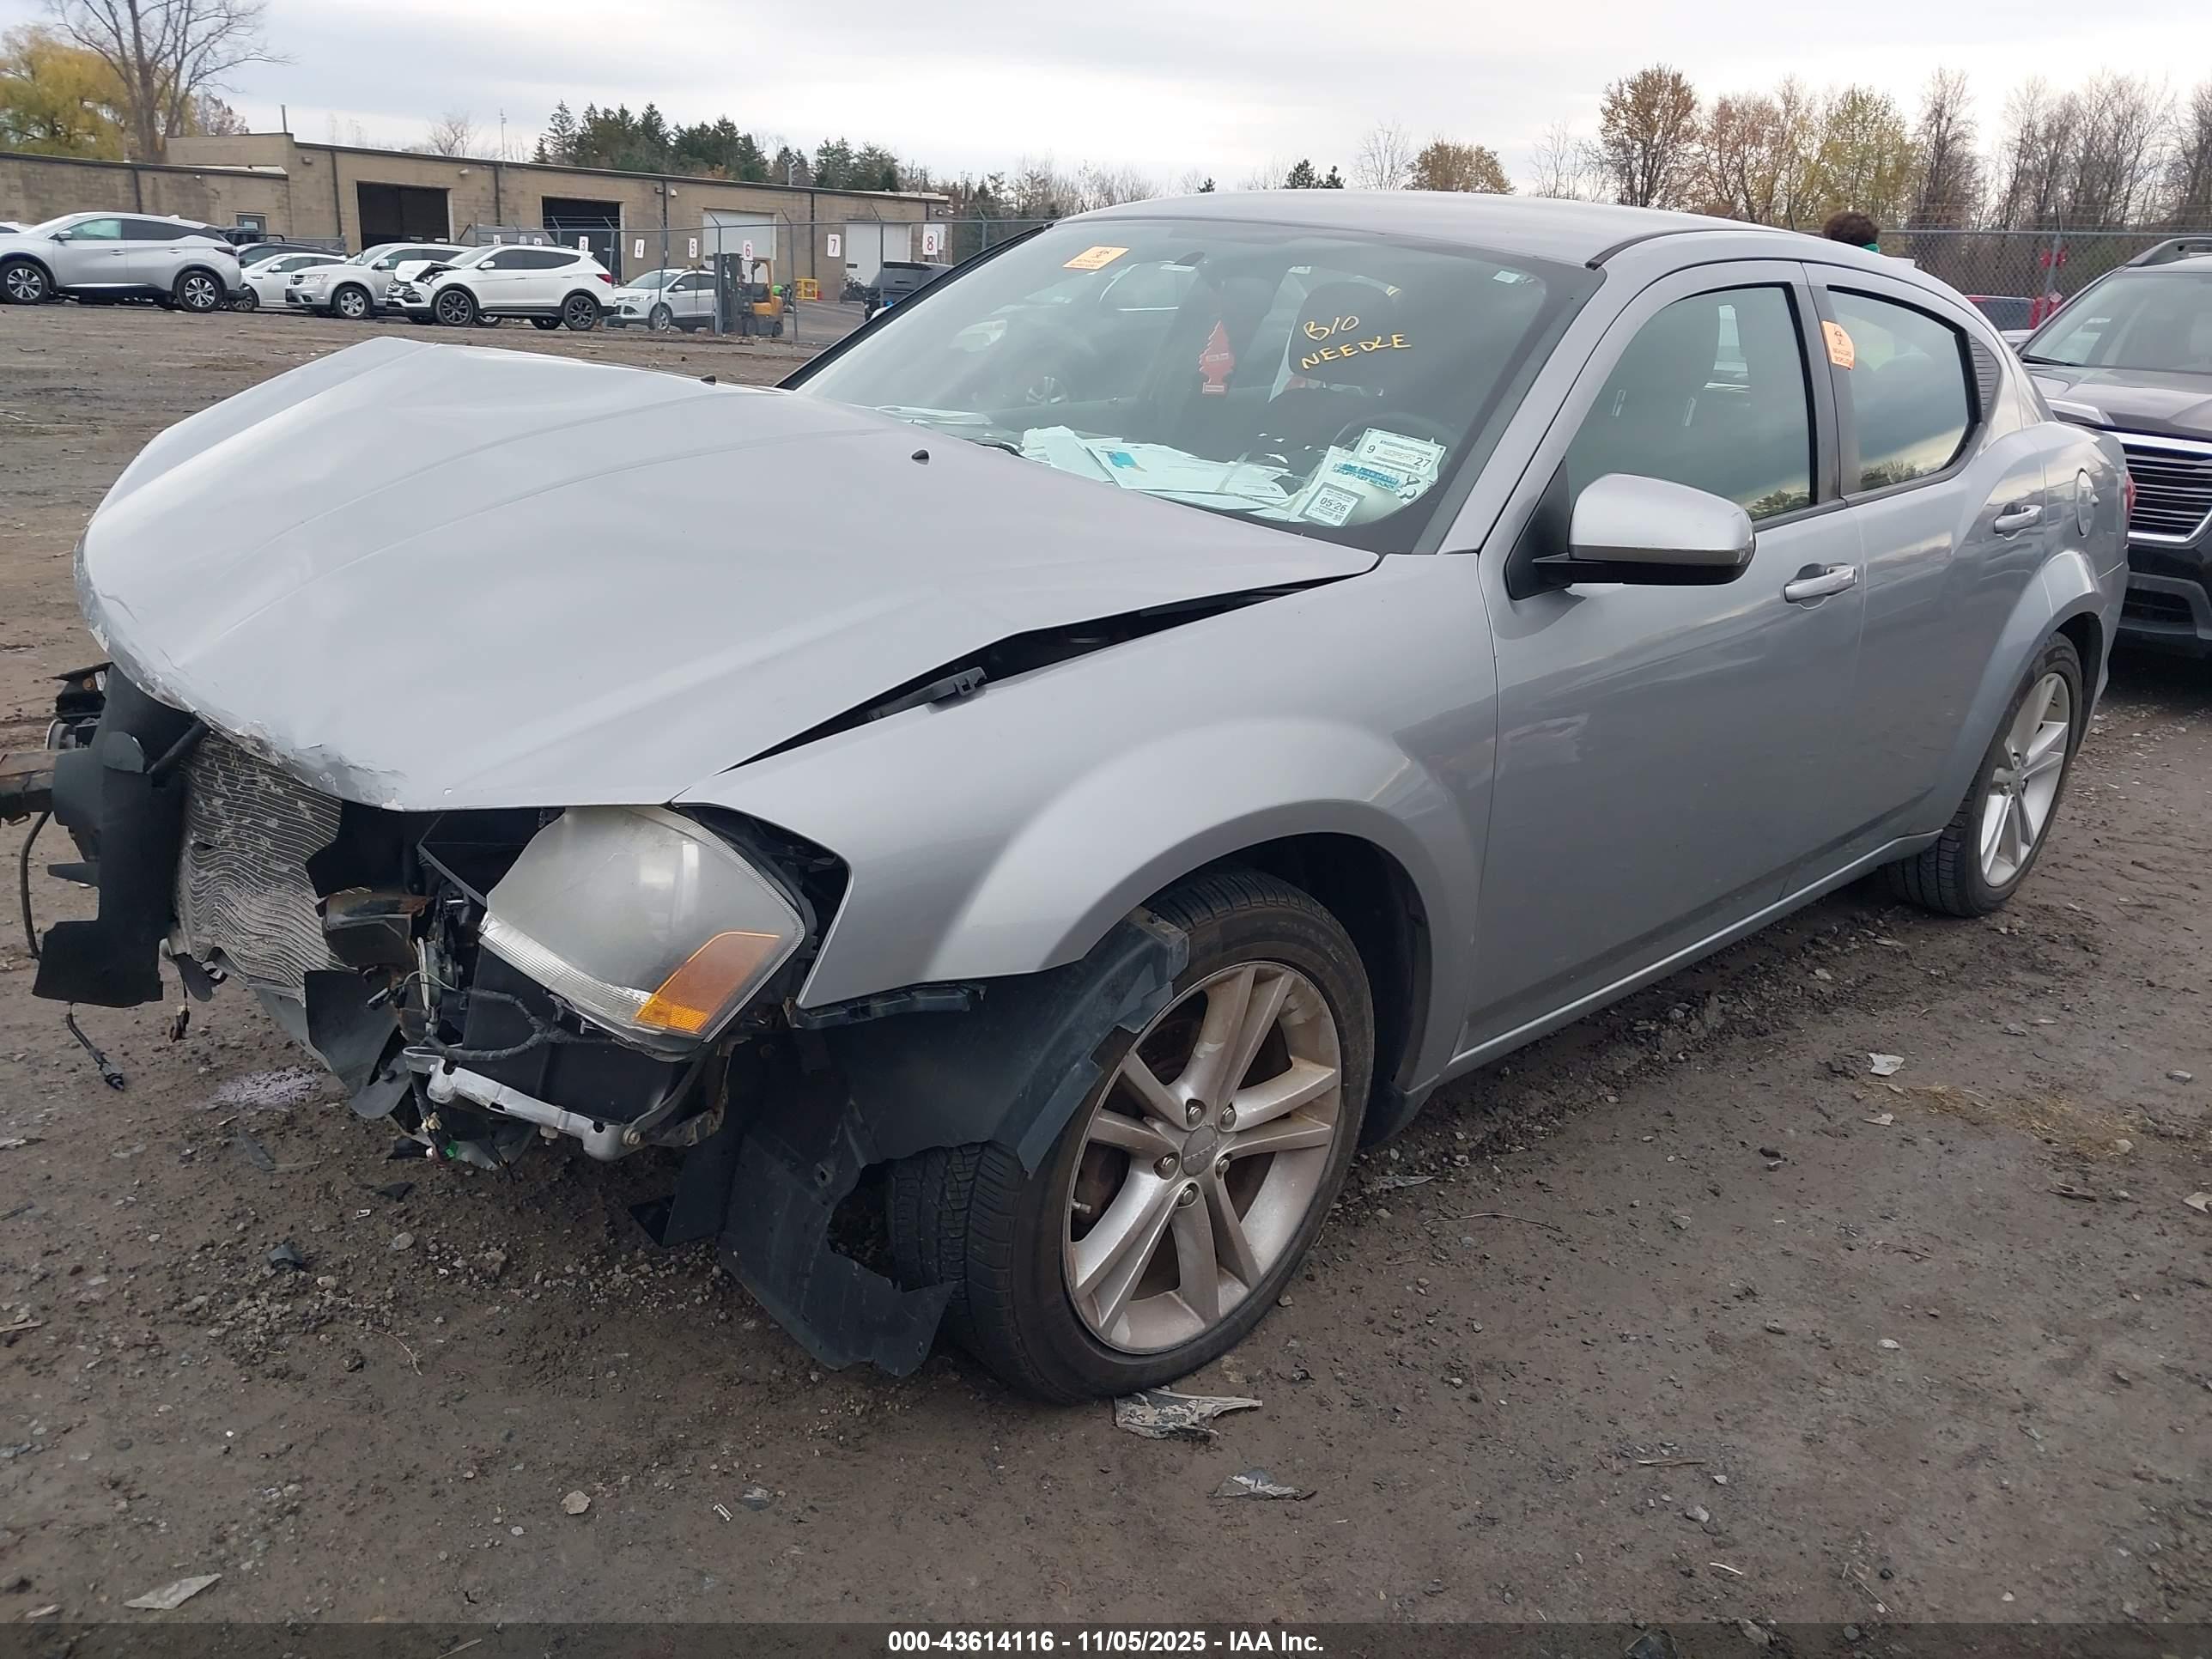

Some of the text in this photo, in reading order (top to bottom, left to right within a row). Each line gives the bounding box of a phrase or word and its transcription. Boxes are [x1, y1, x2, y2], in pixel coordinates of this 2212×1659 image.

[830, 239, 837, 253] 7
[927, 235, 934, 251] 8
[744, 244, 751, 257] 6
[1301, 333, 1412, 369] NEEDLE
[1366, 445, 1376, 454] 9
[1413, 457, 1432, 468] 27
